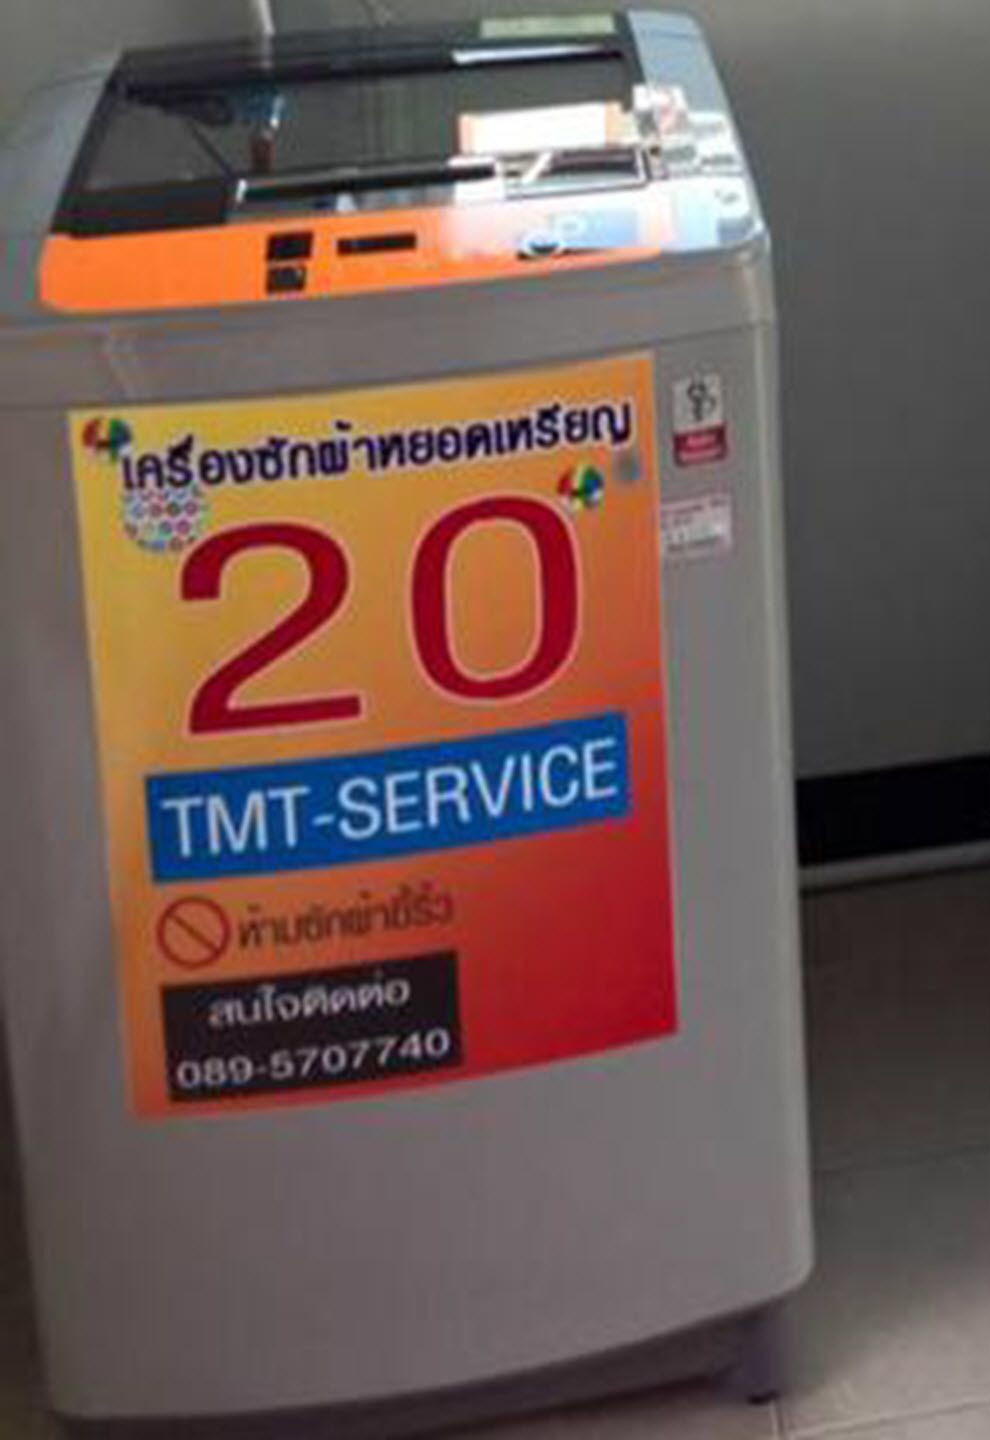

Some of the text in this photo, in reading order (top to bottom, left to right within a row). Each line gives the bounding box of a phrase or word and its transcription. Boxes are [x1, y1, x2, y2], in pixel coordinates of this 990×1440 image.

[179, 494, 581, 735] 20
[161, 738, 619, 859] TMT-SERVICE
[208, 968, 411, 1028] สนใจติดต่อ
[176, 1027, 450, 1089] 089-5707740
